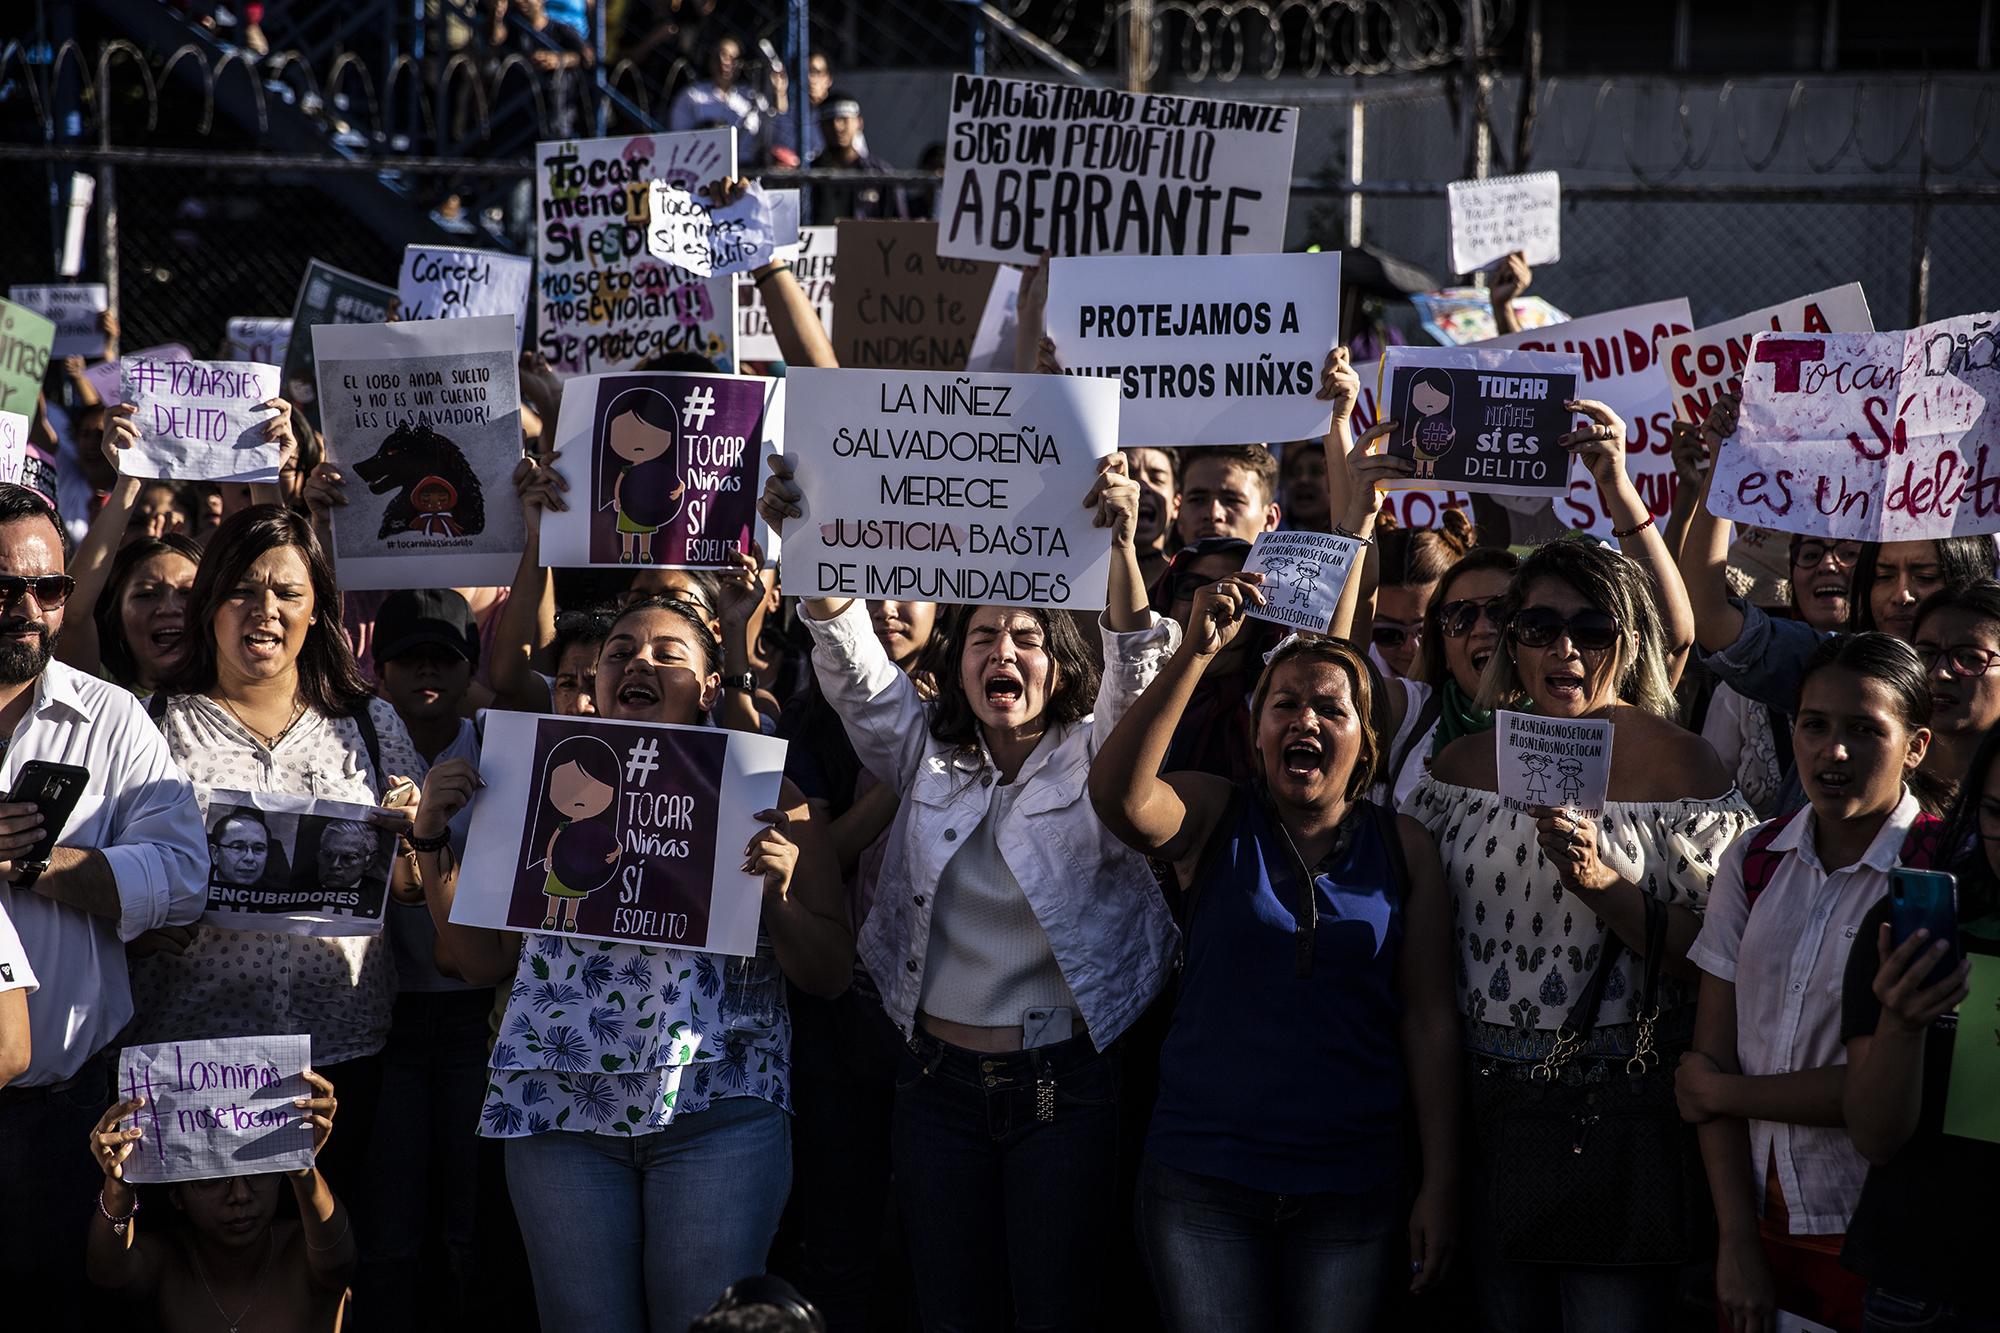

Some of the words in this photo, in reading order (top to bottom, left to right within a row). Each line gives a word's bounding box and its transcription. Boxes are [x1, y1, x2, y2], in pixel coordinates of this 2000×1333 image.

[1140, 95, 1289, 133] ESCALANTE
[953, 122, 1011, 165] SOS
[1019, 124, 1056, 166] UN
[544, 155, 650, 188] Tocar
[948, 168, 1262, 258] ABERRANTE
[443, 283, 470, 307] al
[1080, 302, 1271, 338] PROTEJAMOS
[1279, 302, 1300, 334] A
[853, 335, 974, 367] INDIGNA
[1754, 340, 1917, 396] Tocar
[129, 361, 262, 400] #TOCARSIES
[343, 375, 358, 389] EL
[366, 374, 401, 389] LOBO
[409, 371, 443, 388] ANDA
[452, 367, 490, 384] SUELTO
[1225, 353, 1314, 398] NIÑXS
[1478, 375, 1549, 401] TOCAR
[394, 392, 406, 407] ES
[441, 386, 487, 403] CUENTO
[881, 383, 918, 414] LA
[924, 376, 1013, 417] NIÑEZ
[154, 404, 227, 442] DELITO
[1484, 402, 1536, 429] NIÑAS
[683, 434, 746, 468] TOCAR
[833, 426, 1062, 465] SALVADOREÑA
[1506, 432, 1540, 455] ES
[686, 466, 742, 493] Niñas
[1464, 456, 1548, 480] DELITO
[881, 475, 1010, 509] MERECE
[1738, 470, 1796, 518] es
[686, 493, 708, 536] SÍ
[821, 518, 962, 558] JUSTICIA,
[969, 524, 1070, 558] BASTA
[817, 564, 857, 594] DE
[866, 565, 1071, 604] IMPUNIDADES
[625, 792, 696, 832] TOCAR
[624, 828, 690, 859] Niñas
[207, 885, 360, 906] ENCUBRIDORES
[619, 859, 646, 905] SÍ
[613, 907, 689, 940] ESDELITO
